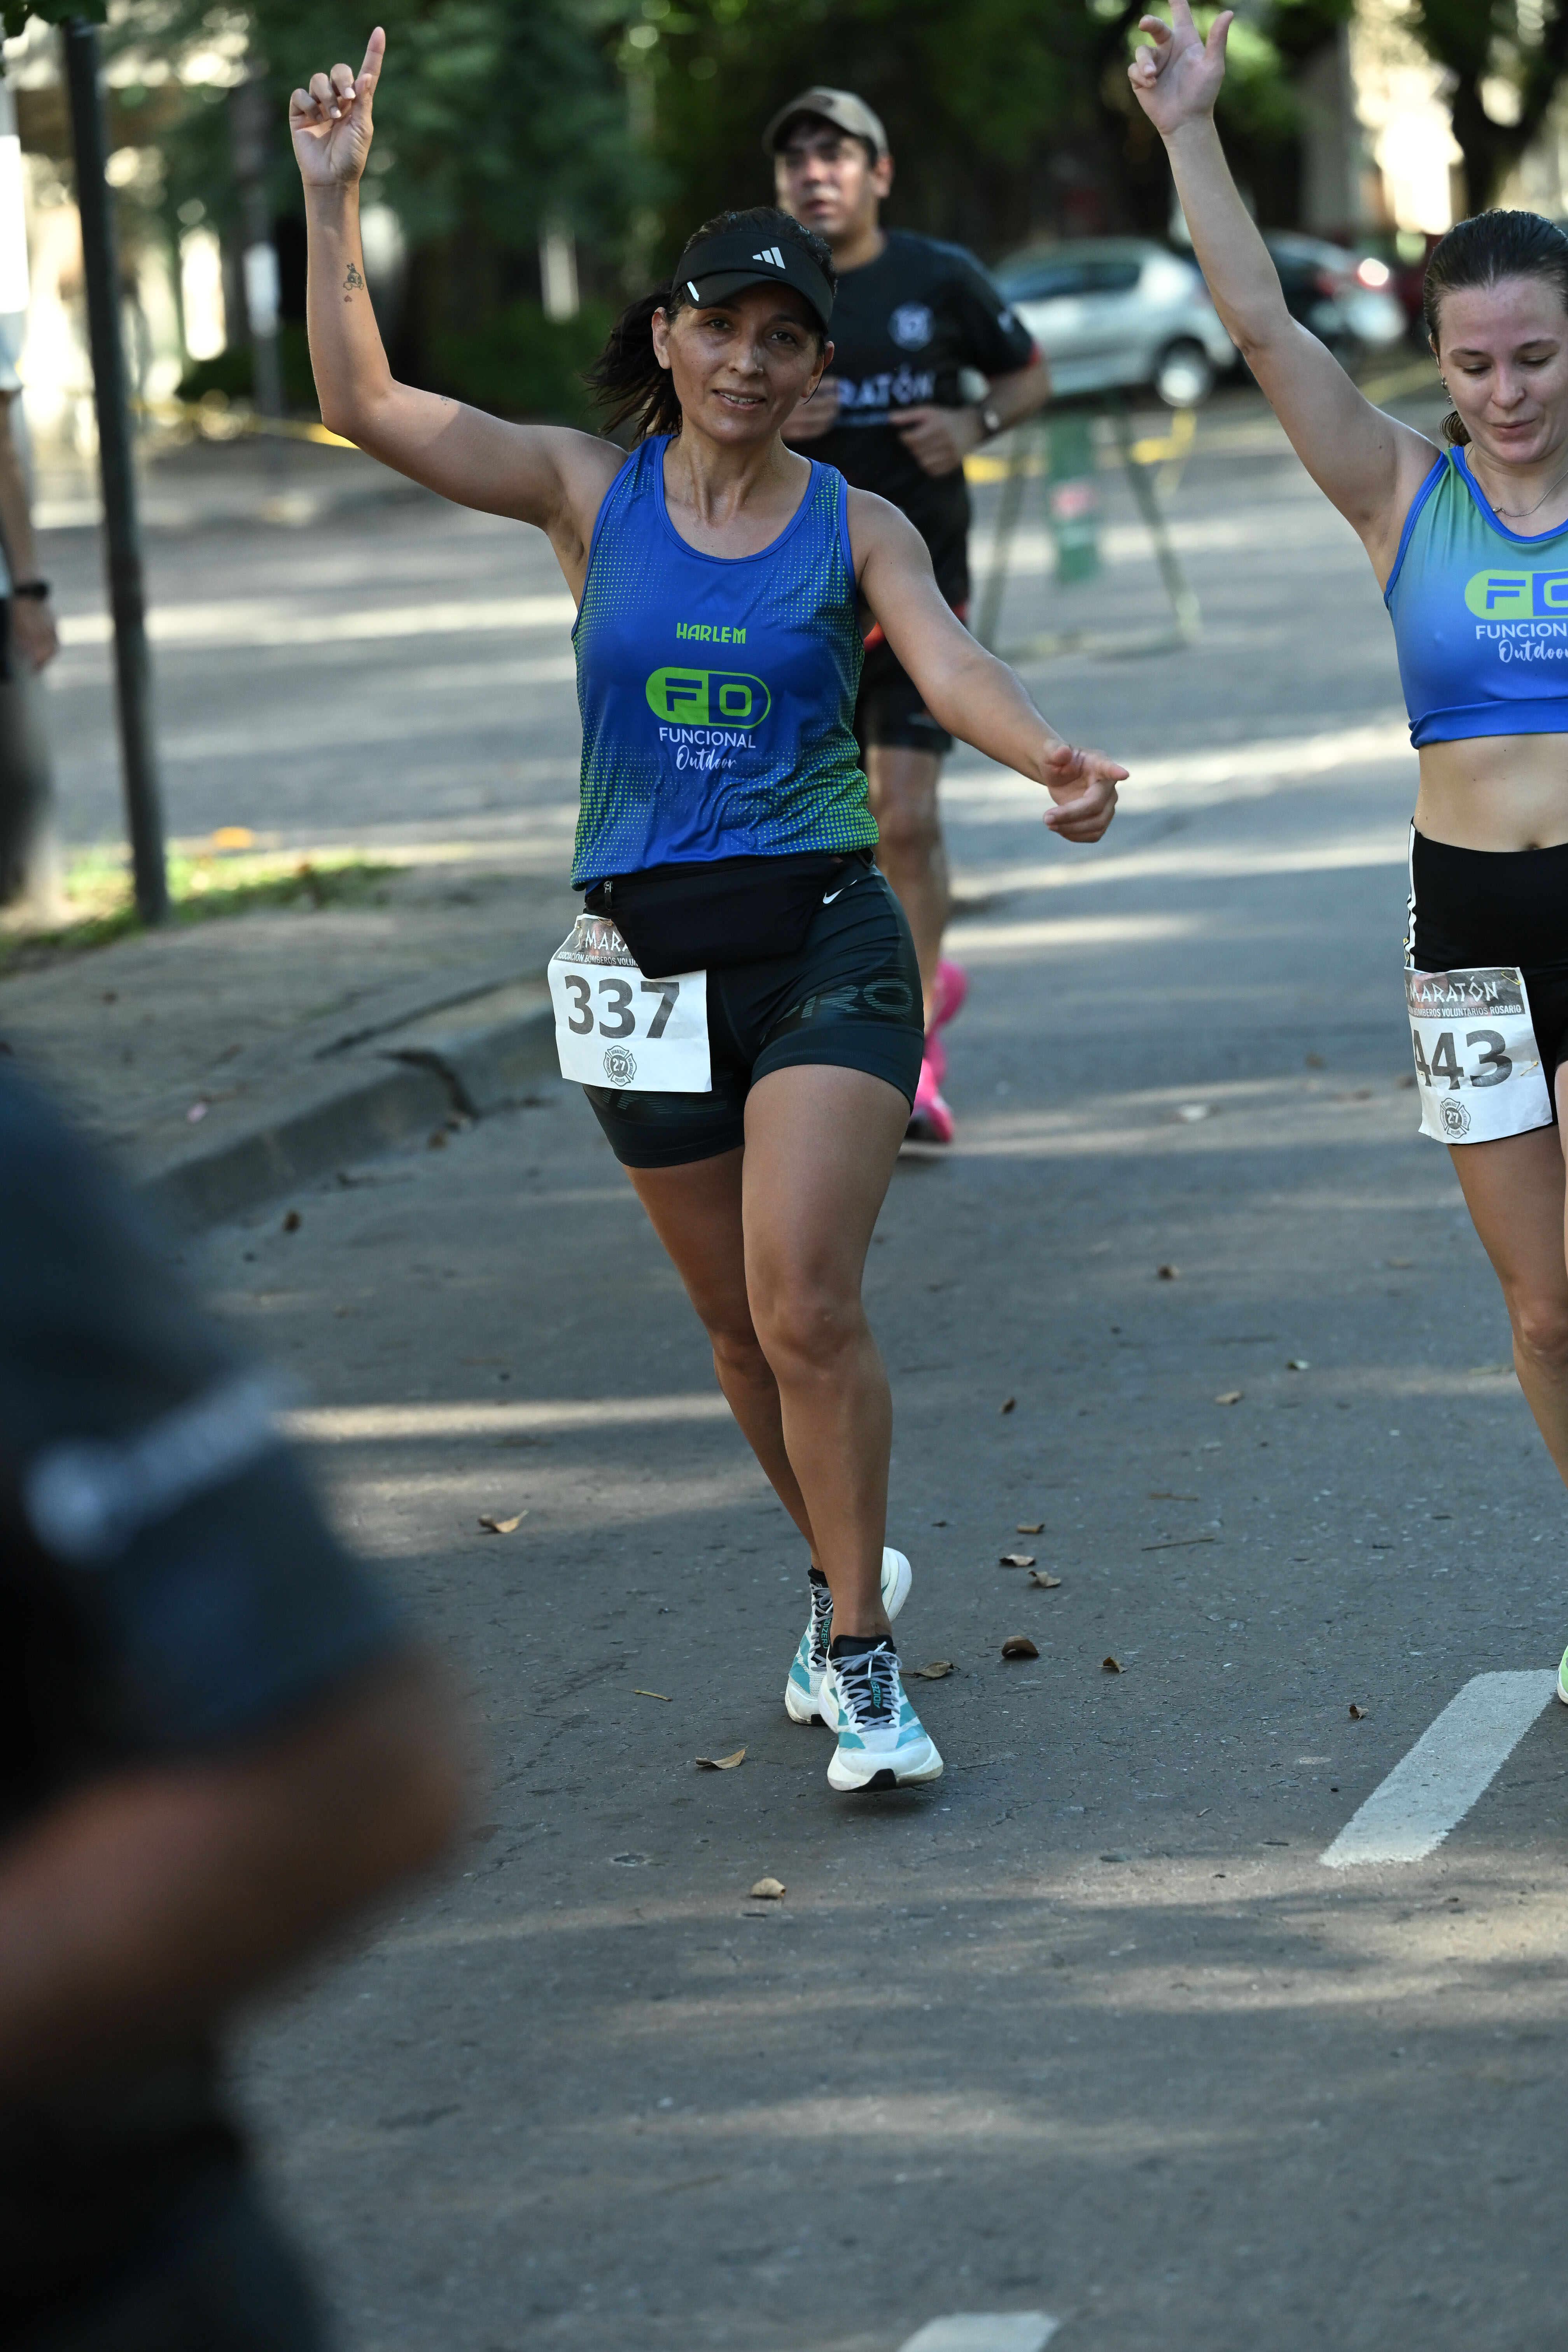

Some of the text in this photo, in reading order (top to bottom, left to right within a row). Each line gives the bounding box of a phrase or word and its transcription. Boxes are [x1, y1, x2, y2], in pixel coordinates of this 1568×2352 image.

[676, 623, 746, 644] HARLEM
[1476, 623, 1567, 639] FUNCION
[659, 728, 756, 748] FUNCIONAL
[676, 745, 737, 770] Outdoor
[557, 952, 584, 962] ASOCIACIÓN
[584, 955, 616, 964] BOMBEROS
[1410, 976, 1498, 1003] MARATÓN
[564, 975, 679, 1038] 337
[1413, 1008, 1440, 1017] BOMBEROS
[1442, 1007, 1488, 1017] VOLUNTARIOS
[1490, 1005, 1521, 1014] ROSARIO
[613, 1058, 625, 1071] 27
[1413, 1029, 1512, 1090] 443
[1446, 1110, 1459, 1124] 27
